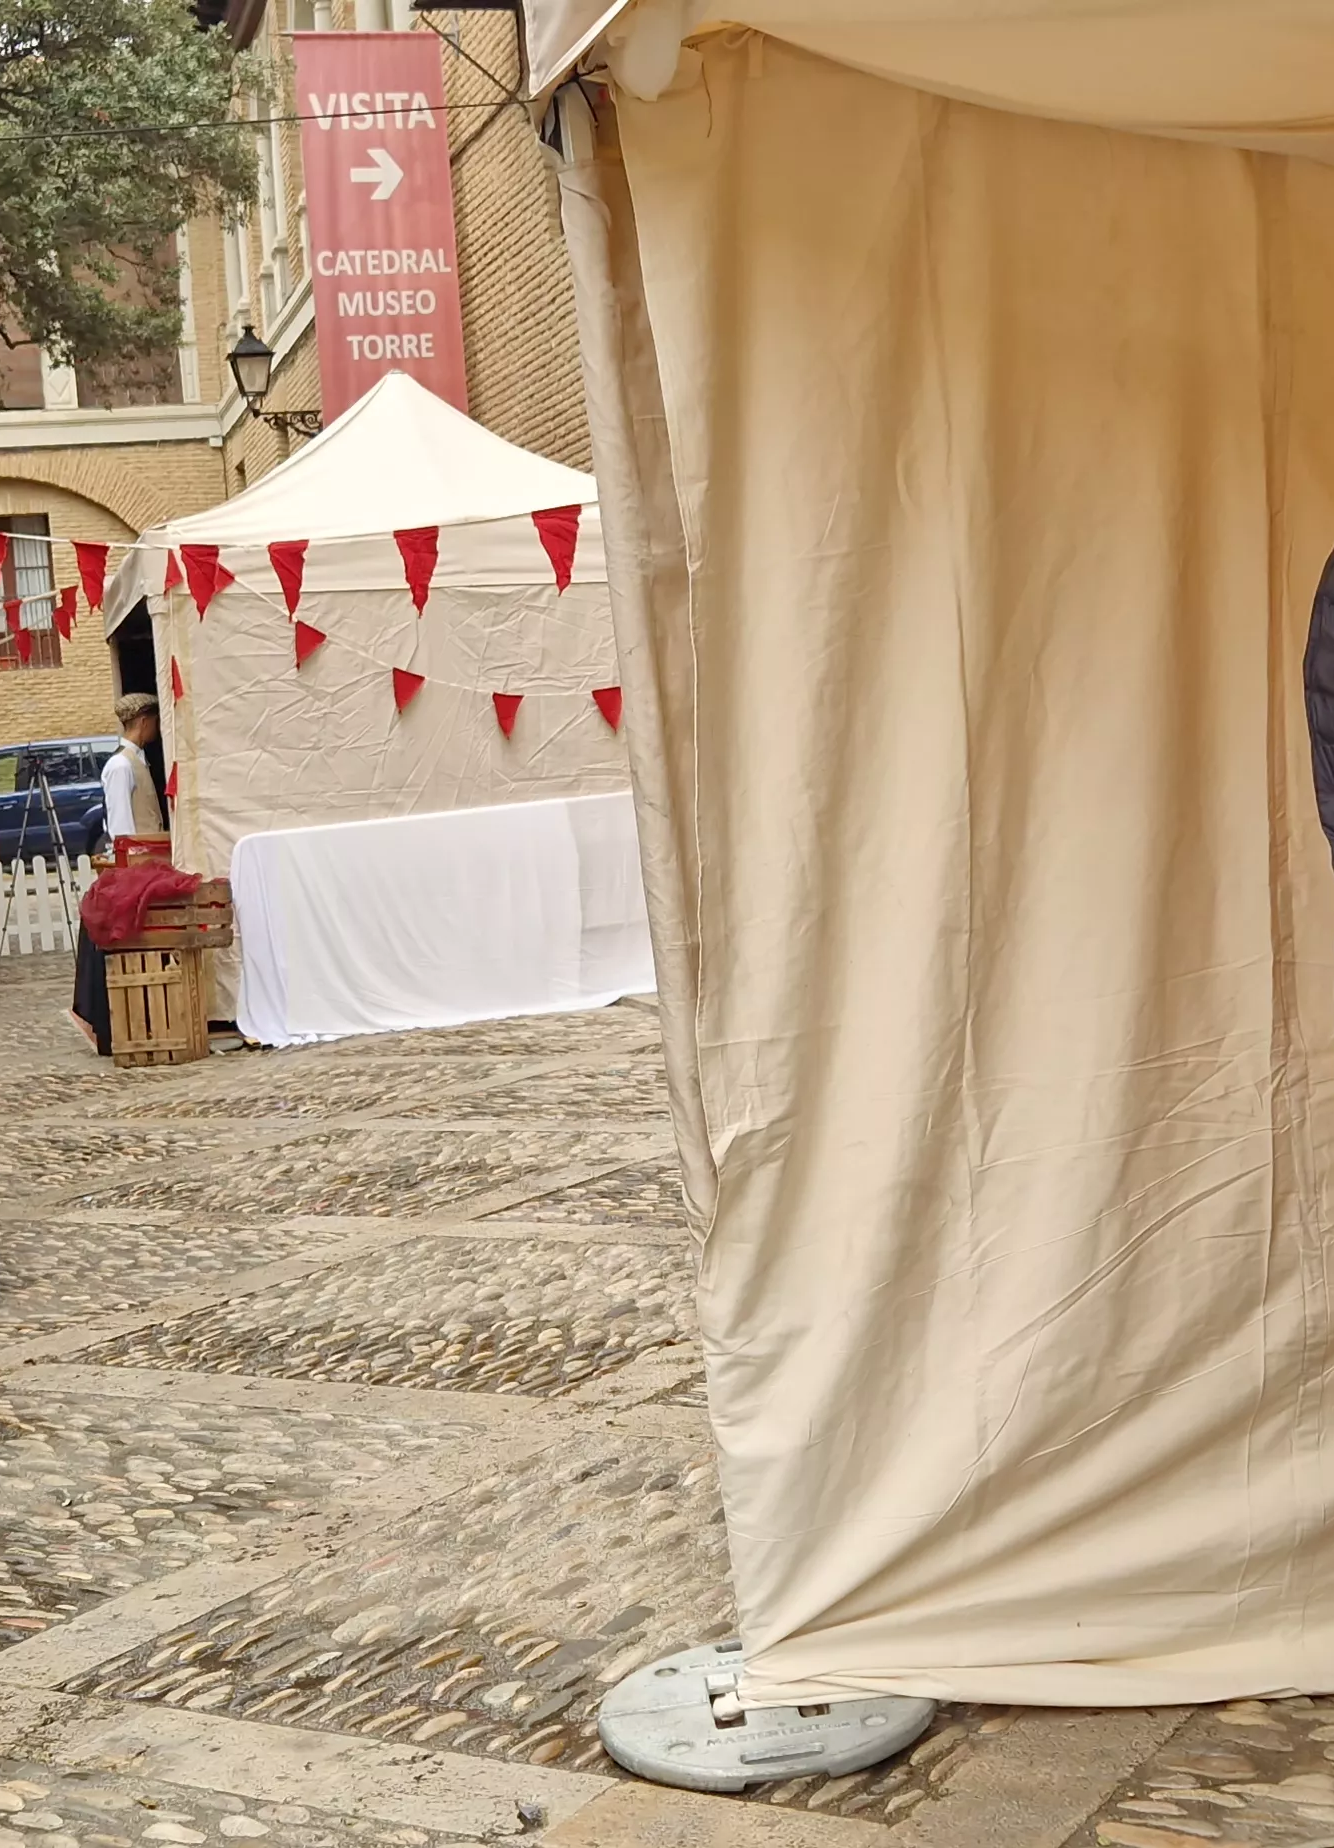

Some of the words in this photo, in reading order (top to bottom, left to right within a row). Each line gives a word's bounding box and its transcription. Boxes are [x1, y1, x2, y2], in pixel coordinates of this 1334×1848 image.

[308, 92, 436, 131] VISITA
[317, 248, 451, 277] CATEDRAL
[338, 290, 436, 318] MUSEO
[347, 333, 435, 361] TORRE
